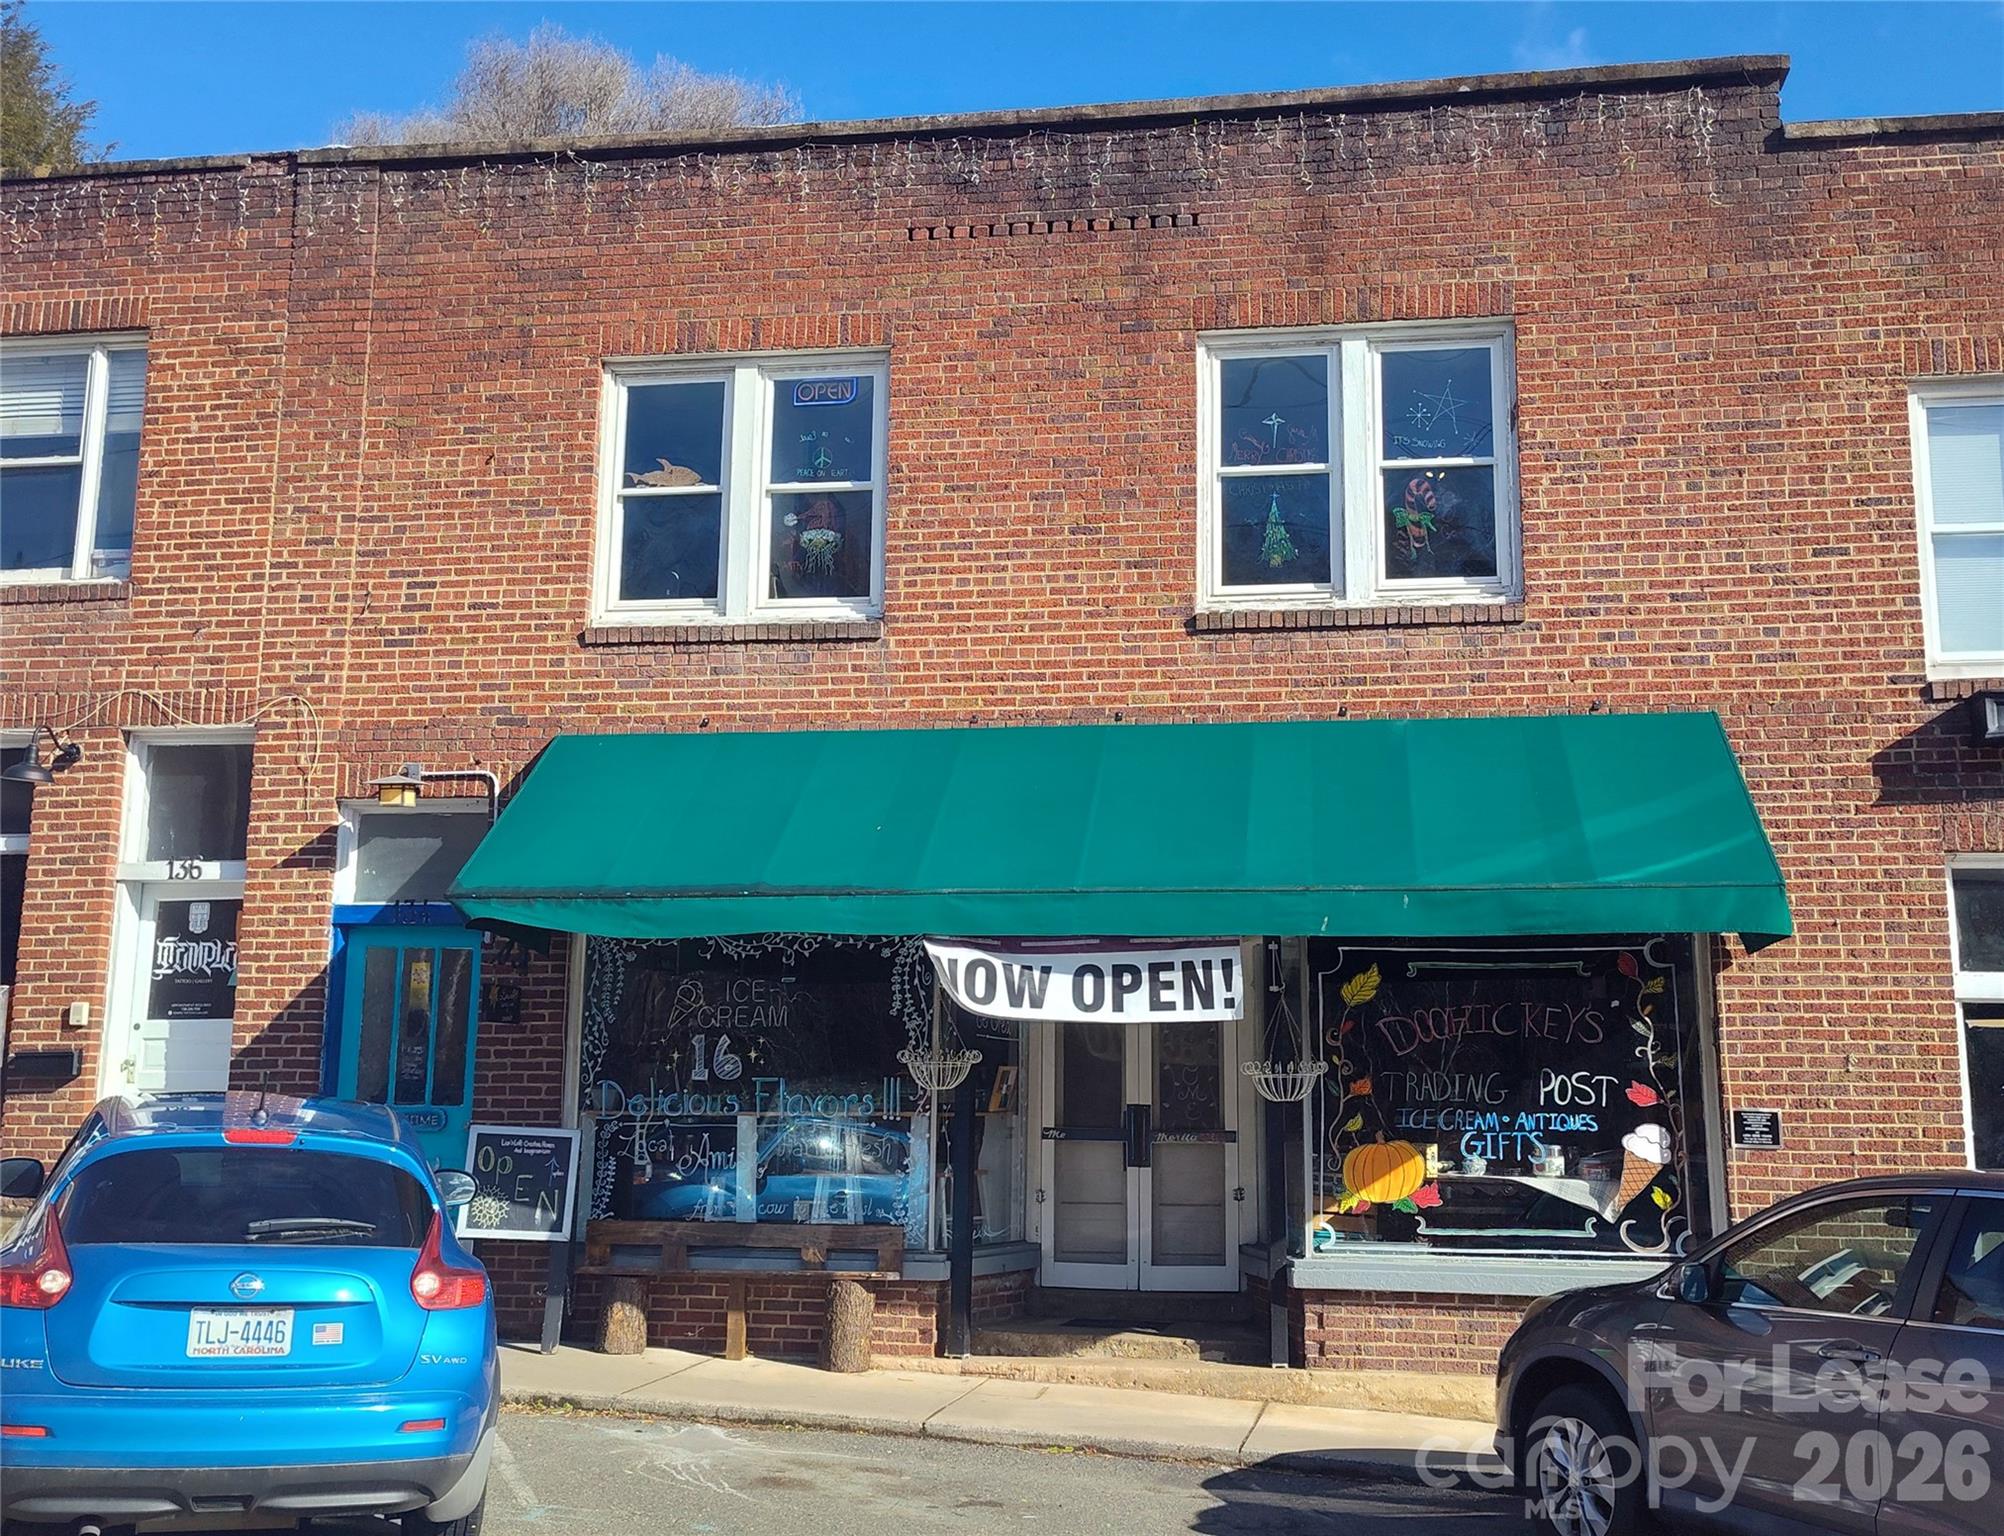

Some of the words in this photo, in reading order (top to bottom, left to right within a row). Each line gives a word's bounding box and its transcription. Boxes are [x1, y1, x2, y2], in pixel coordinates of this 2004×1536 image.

[797, 382, 852, 401] OPEN
[166, 855, 203, 881] 136
[1072, 957, 1236, 1013] OPEN!
[697, 1005, 788, 1029] CREAM
[691, 1034, 743, 1081] 16
[596, 1077, 739, 1120] Delicious
[751, 1076, 875, 1119] Flavors
[1380, 1071, 1510, 1105] TRADING
[1539, 1067, 1620, 1108] POST
[1395, 1107, 1437, 1129] ICE
[1437, 1107, 1500, 1132] CREAM
[1514, 1110, 1599, 1132] ANTIQUES
[1459, 1131, 1548, 1164] GIFTS
[196, 1320, 287, 1344] TLJ-4446
[192, 1346, 230, 1355] NORTH
[233, 1345, 286, 1355] CAROLINA
[420, 1354, 442, 1364] SV
[443, 1356, 468, 1365] AWD
